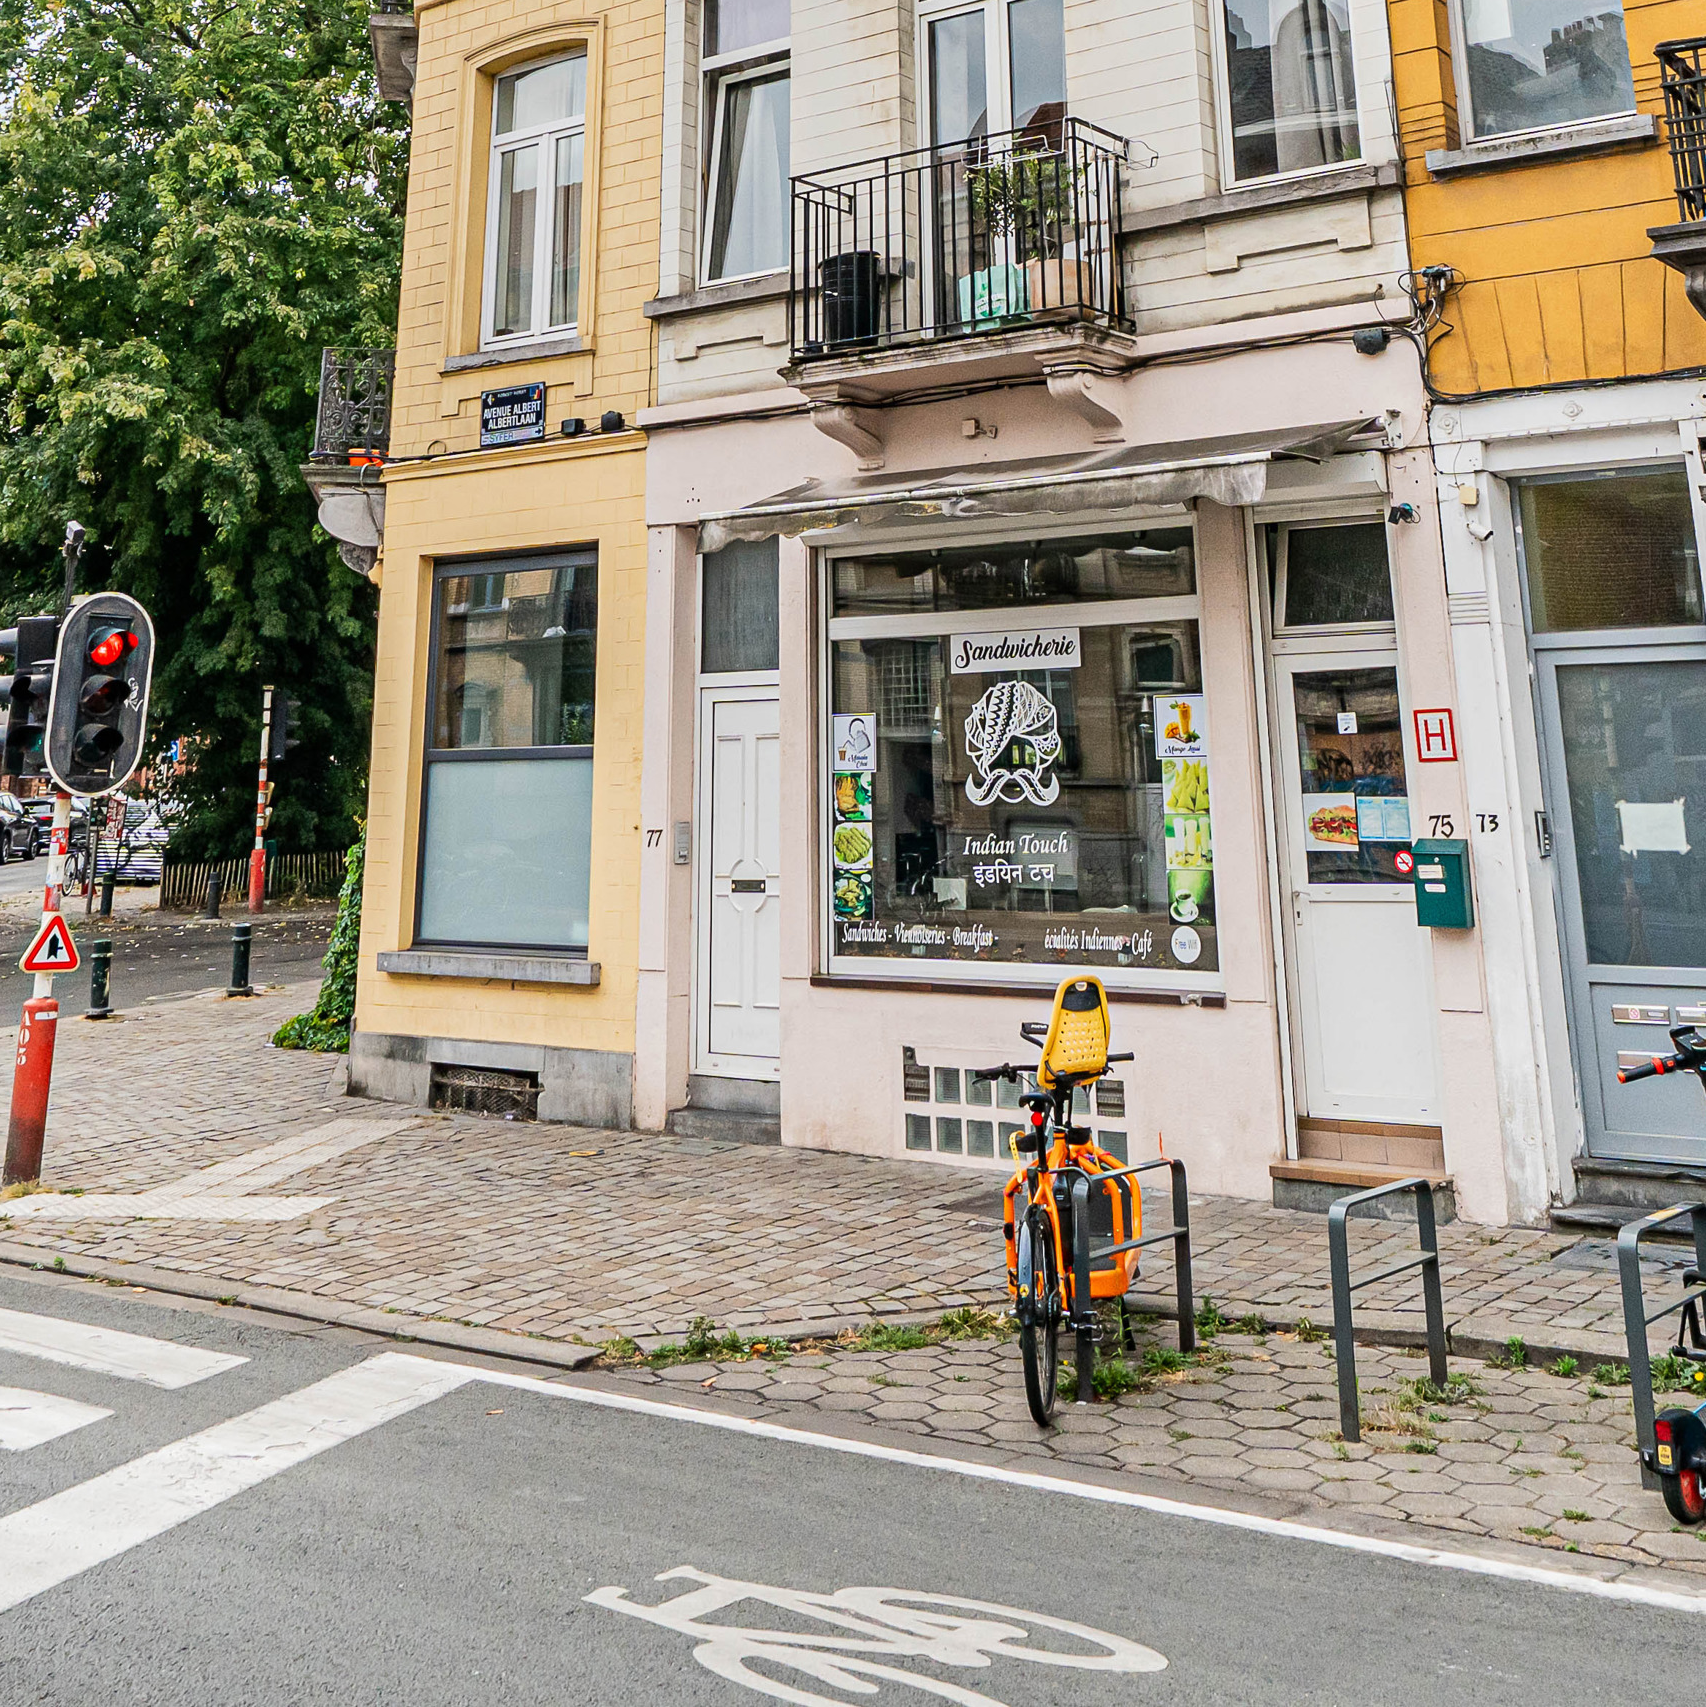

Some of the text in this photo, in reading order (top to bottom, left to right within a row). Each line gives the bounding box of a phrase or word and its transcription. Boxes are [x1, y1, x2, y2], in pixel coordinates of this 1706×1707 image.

[483, 400, 542, 420] AVENUE ALBERT
[488, 413, 536, 430] ALBERTLAAN
[954, 634, 1076, 670] Sandwicherie
[1423, 718, 1448, 752] H
[1428, 814, 1455, 838] 75
[1475, 813, 1500, 834] 73
[646, 829, 664, 848] 77
[962, 831, 1069, 857] Indian Touch
[1028, 863, 1055, 883] टच
[842, 921, 994, 953] Sandwiches Viennoiseries Breakfast
[1080, 926, 1123, 951] Indiennes
[1131, 928, 1153, 960] Café
